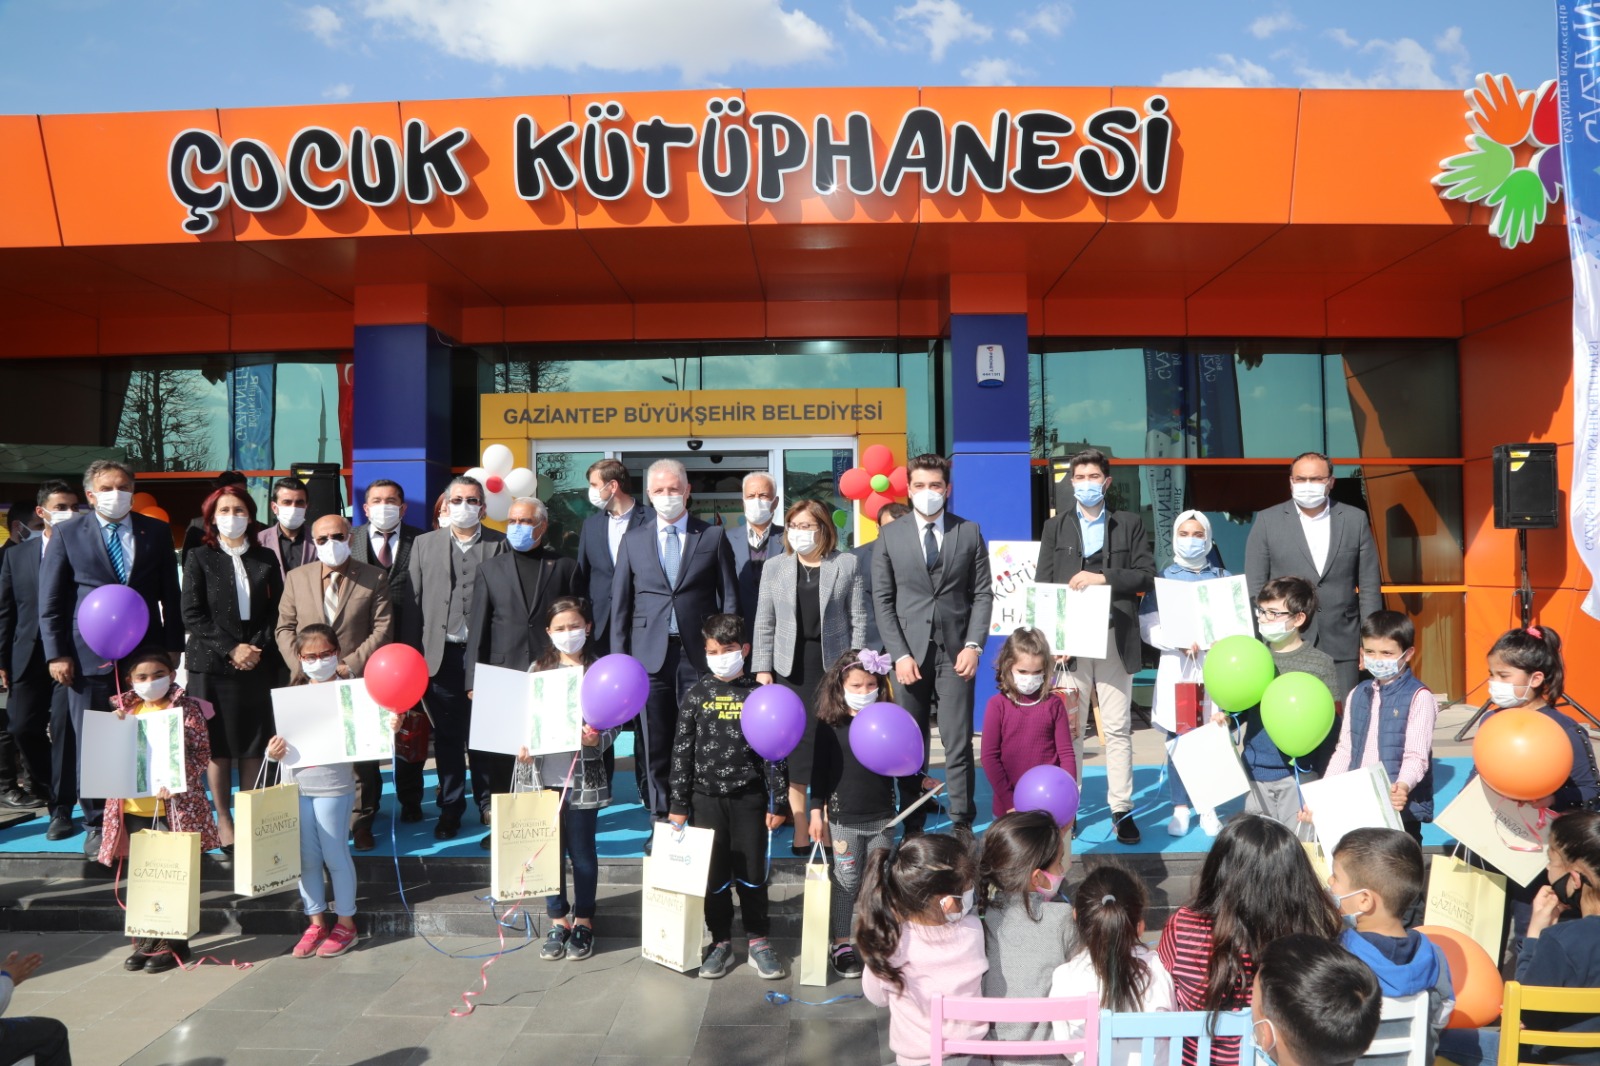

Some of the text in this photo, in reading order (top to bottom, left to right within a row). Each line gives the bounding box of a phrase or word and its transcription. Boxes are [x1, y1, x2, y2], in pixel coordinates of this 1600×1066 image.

[167, 94, 1172, 234] ÇOCUK KÜTÜPHANESİ
[503, 400, 882, 426] GAZİANTEP BÜYÜKŞEHİR BELEDİYESİ
